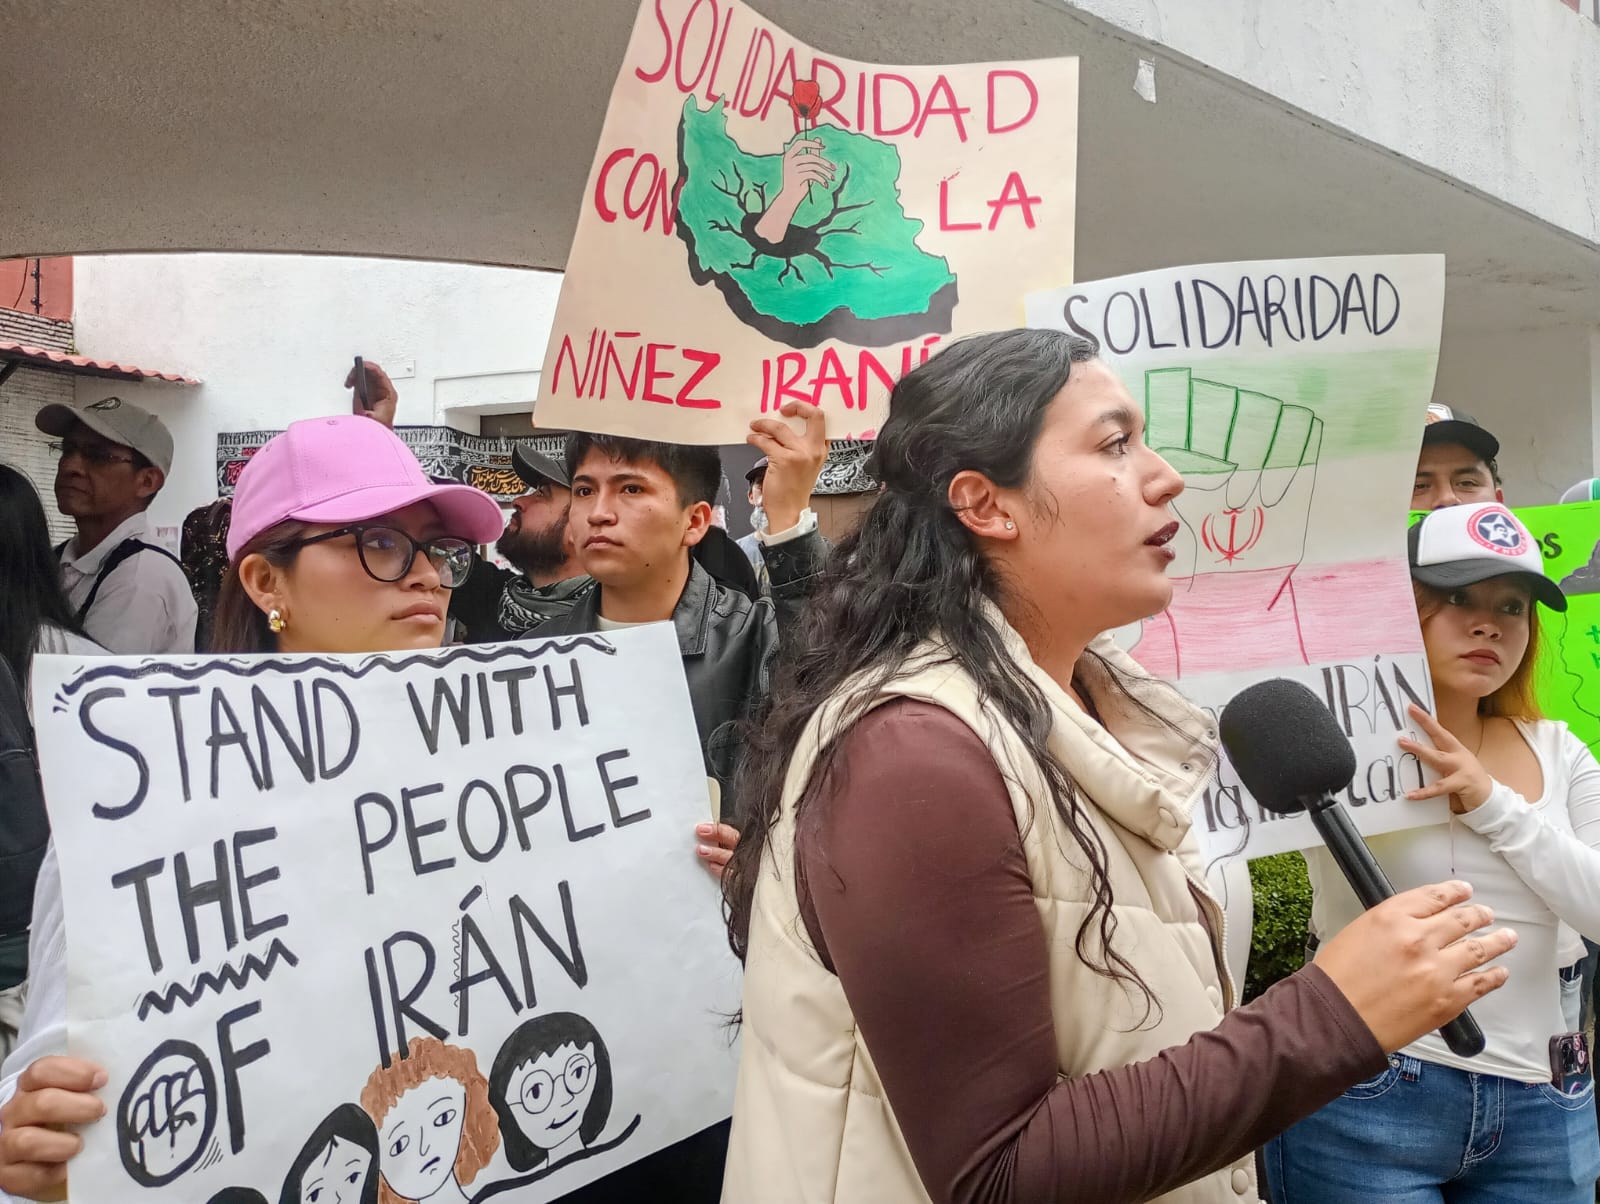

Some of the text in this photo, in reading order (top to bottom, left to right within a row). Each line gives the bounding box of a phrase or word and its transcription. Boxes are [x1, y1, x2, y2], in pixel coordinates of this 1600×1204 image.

[635, 0, 1038, 142] SOLIDARIDAD
[594, 148, 1043, 236] CON LA
[551, 326, 721, 408] NIÑEZ
[1063, 272, 1400, 355] SOLIDARIDAD
[79, 658, 591, 820] STAND WITH
[1321, 654, 1432, 737] IRÁN
[111, 748, 651, 975] THE PEOPLE
[364, 880, 588, 1068] IRÁN
